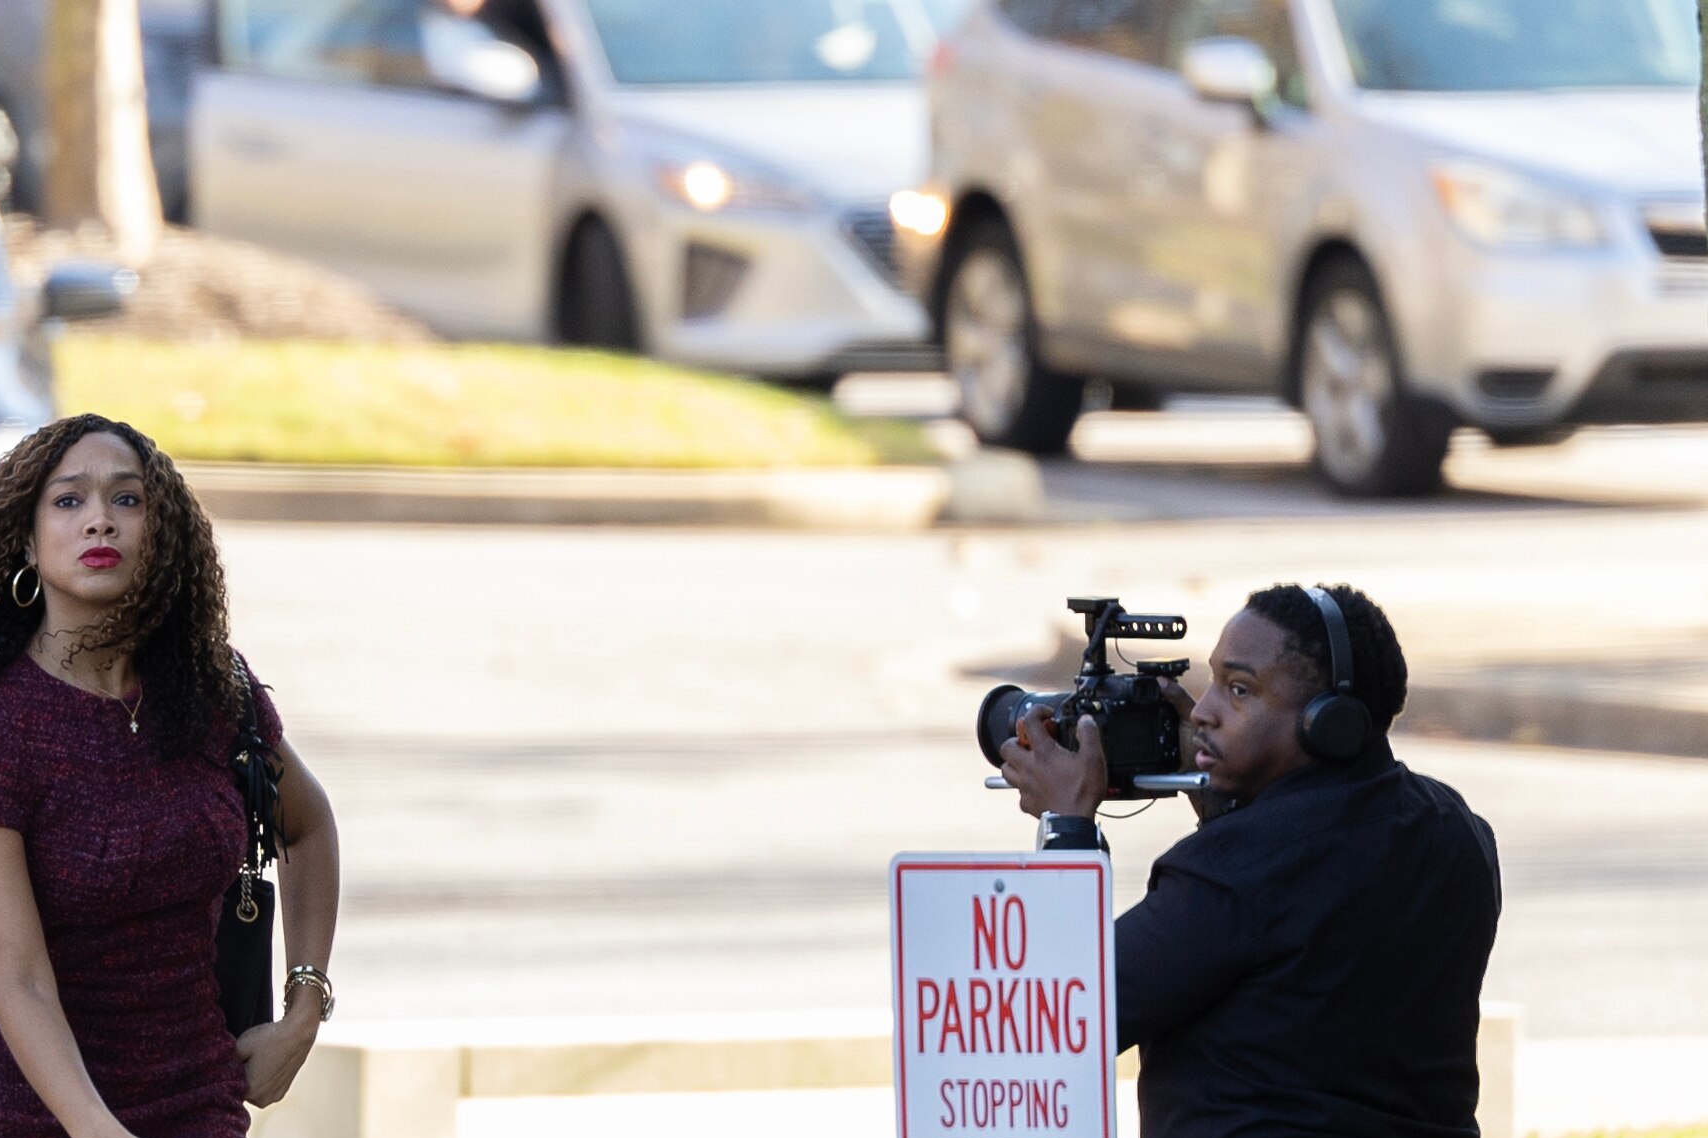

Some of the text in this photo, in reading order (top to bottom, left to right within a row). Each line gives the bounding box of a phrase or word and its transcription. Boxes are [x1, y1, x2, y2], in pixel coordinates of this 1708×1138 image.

[973, 895, 1027, 970] NO
[917, 978, 1087, 1054] PARKING
[940, 1079, 1068, 1128] STOPPING
